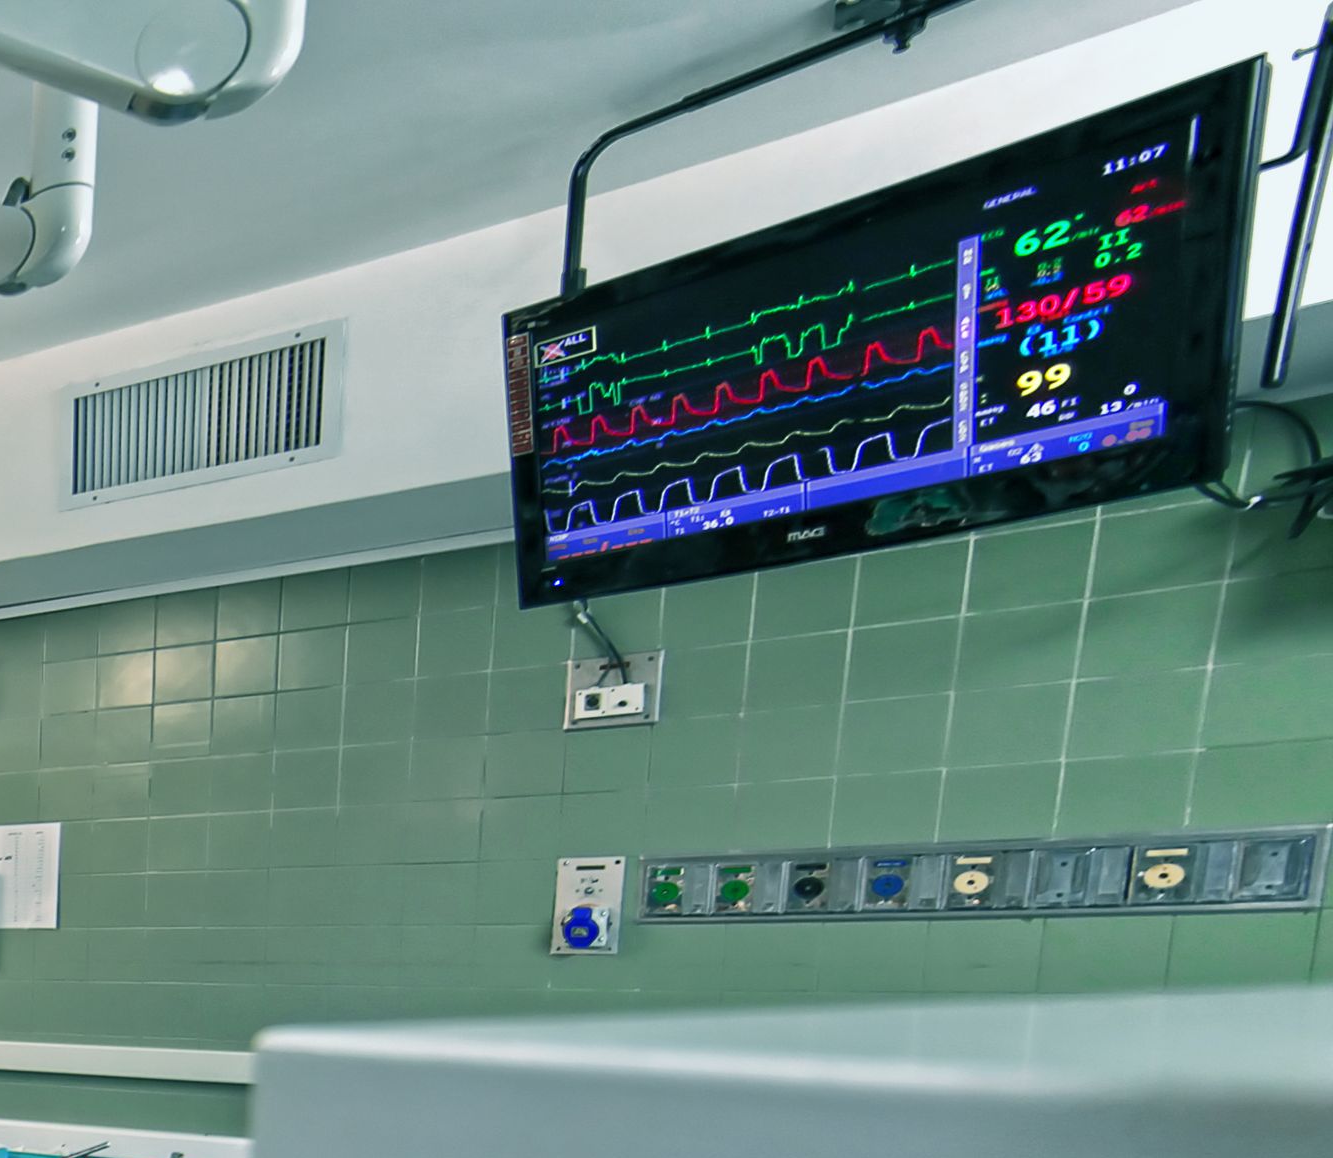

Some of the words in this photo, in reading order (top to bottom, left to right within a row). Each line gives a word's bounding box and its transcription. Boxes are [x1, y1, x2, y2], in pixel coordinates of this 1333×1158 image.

[1102, 144, 1169, 176] 11:07
[1115, 205, 1150, 227] 62
[1014, 219, 1072, 257] 62
[1094, 242, 1144, 269] 0.2
[995, 273, 1133, 330] 130/59
[564, 333, 588, 348] ALL
[1019, 318, 1102, 357] (11)
[1016, 363, 1072, 397] 99
[1025, 399, 1057, 418] 46
[1099, 399, 1123, 416] 13
[702, 515, 735, 531] 36.0
